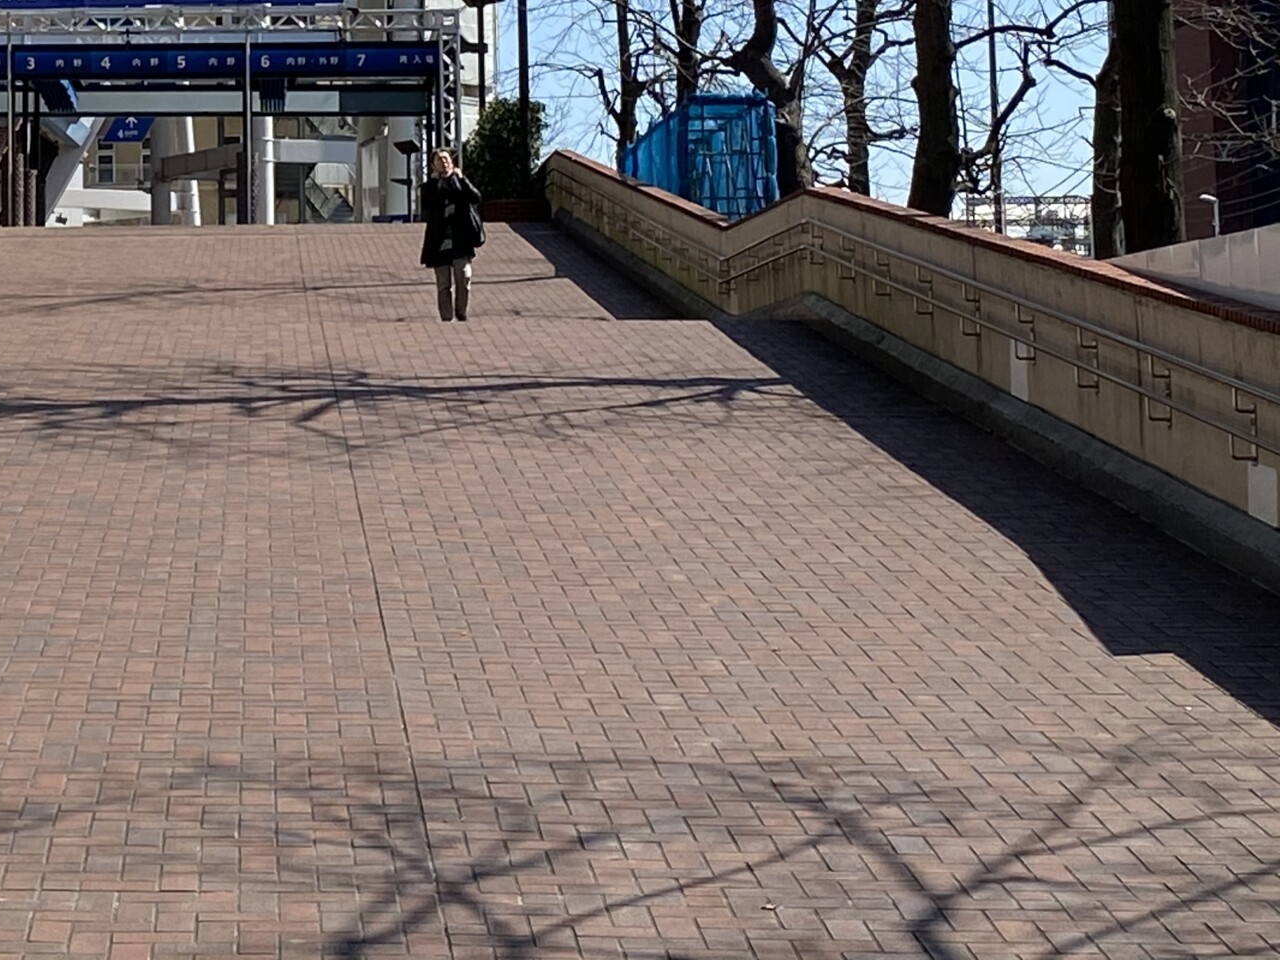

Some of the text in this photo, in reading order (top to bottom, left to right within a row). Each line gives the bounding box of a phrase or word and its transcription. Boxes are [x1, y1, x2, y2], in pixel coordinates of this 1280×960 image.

[26, 56, 35, 70] 3
[100, 56, 111, 70] 4
[177, 55, 186, 69] 5
[260, 54, 270, 68] 6
[356, 53, 366, 67] 7
